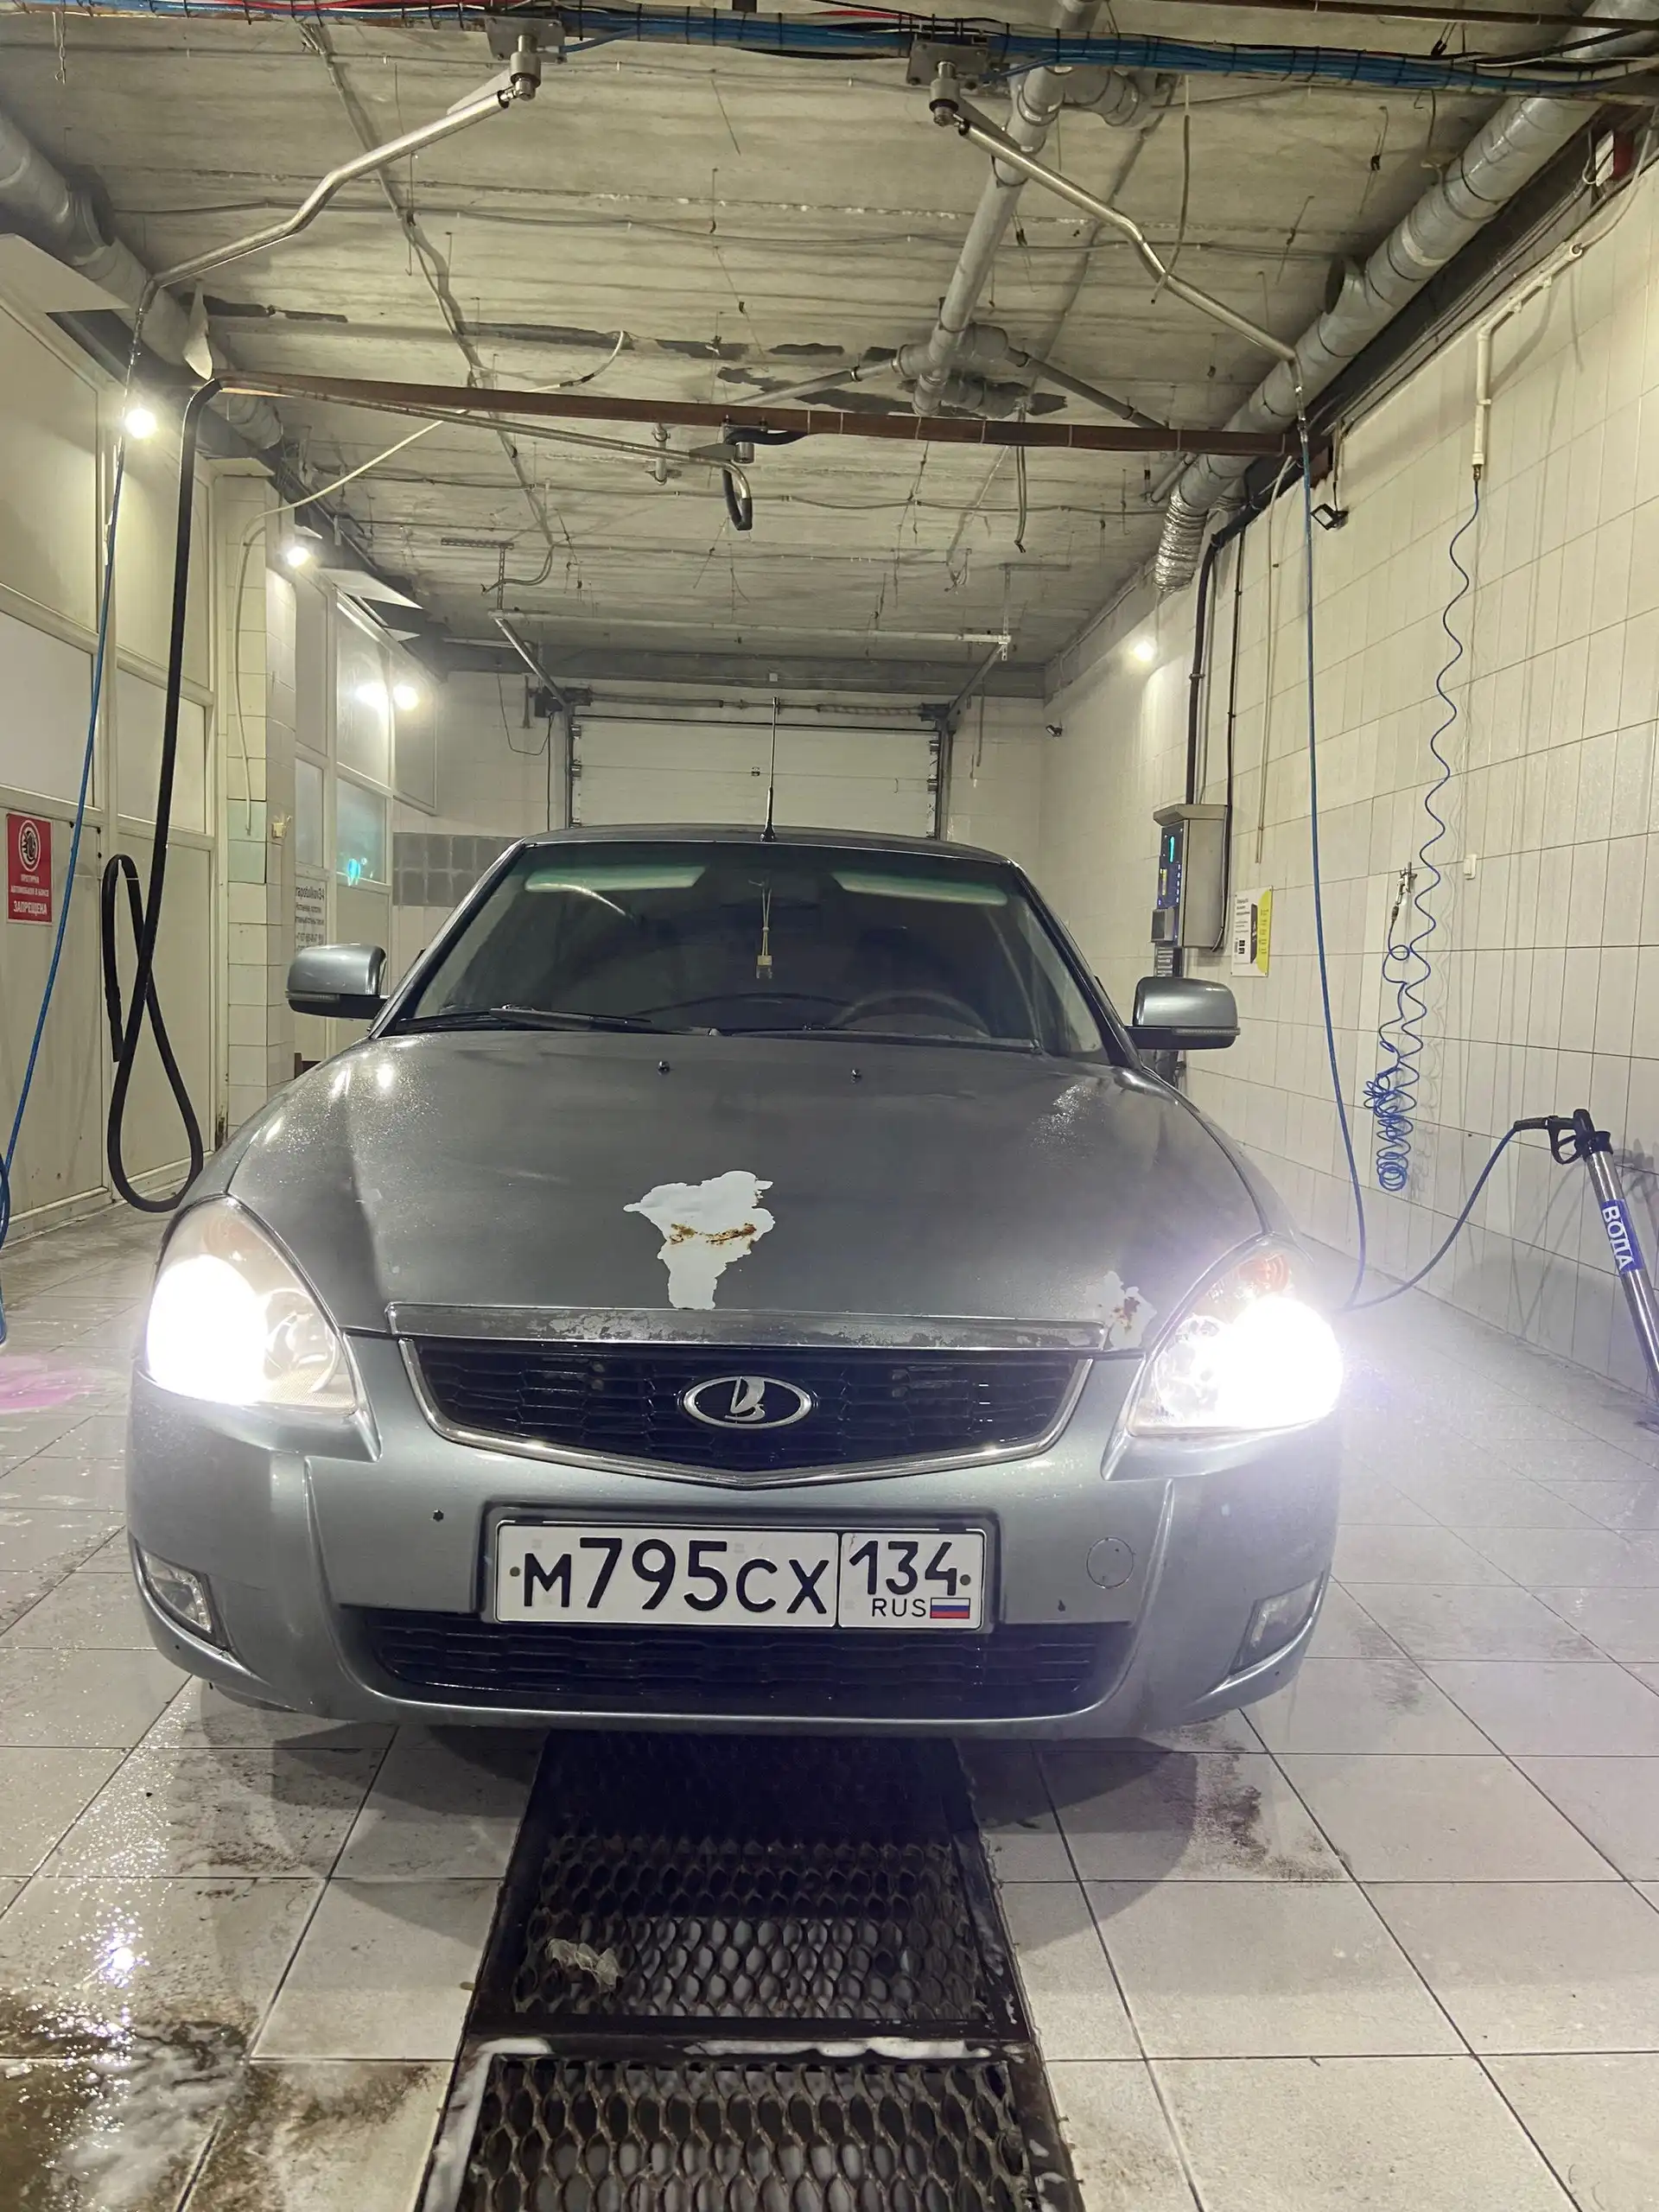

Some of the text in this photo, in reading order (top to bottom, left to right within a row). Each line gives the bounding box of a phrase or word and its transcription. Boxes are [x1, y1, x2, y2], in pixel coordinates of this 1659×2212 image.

[13, 899, 48, 916] ЗАПРЕЩЕНА
[1602, 1205, 1635, 1270] ВОДА
[849, 1541, 958, 1597] 134
[871, 1598, 927, 1618] RUS
